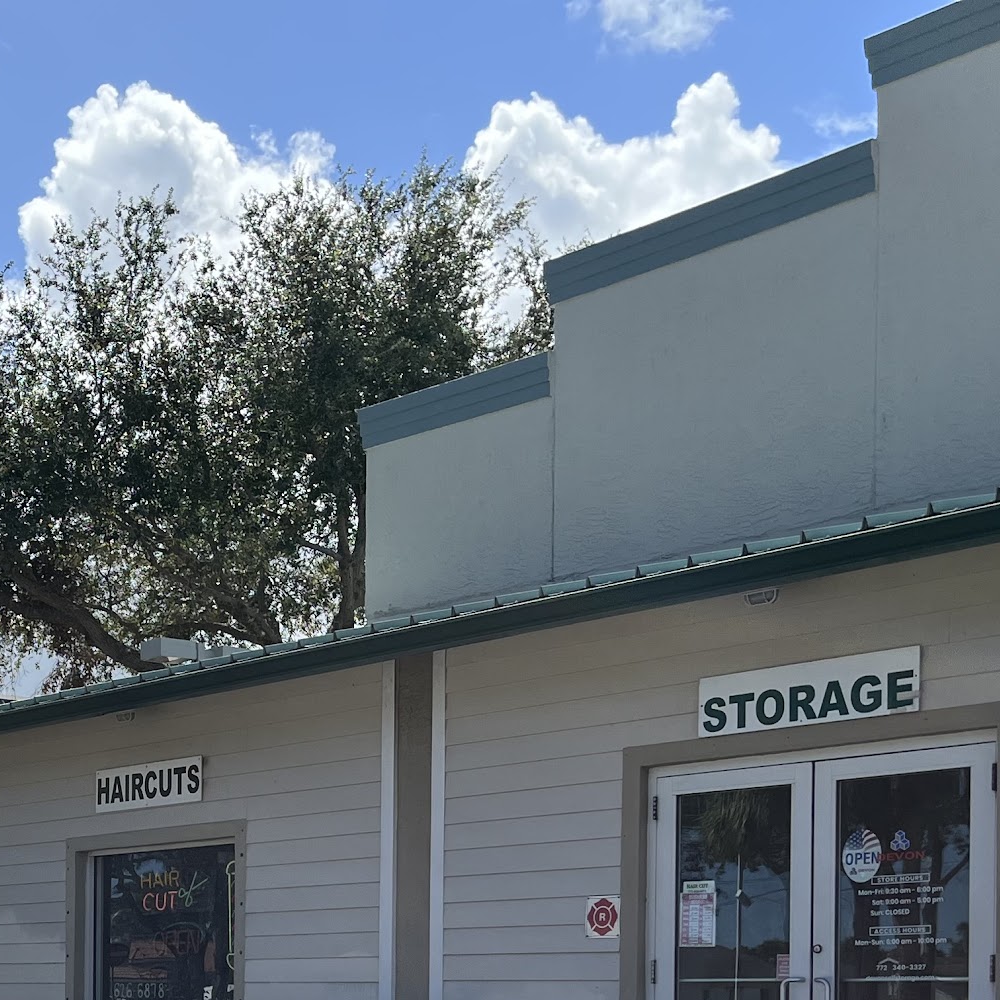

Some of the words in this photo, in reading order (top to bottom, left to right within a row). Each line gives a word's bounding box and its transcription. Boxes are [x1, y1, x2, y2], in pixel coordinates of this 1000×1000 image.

[703, 670, 914, 732] STORAGE
[97, 765, 200, 805] HAIRCUTS
[845, 852, 880, 865] OPEN
[877, 850, 925, 861] DEVON
[140, 870, 179, 889] HAIR
[899, 874, 923, 882] HOURS
[931, 886, 944, 894] pm
[142, 890, 178, 911] CUT
[931, 897, 944, 905] pm
[598, 912, 607, 922] R
[870, 909, 884, 917] Sun:
[885, 908, 910, 916] CLOSED
[152, 929, 200, 955] OPEN
[892, 963, 927, 971] 340-3327
